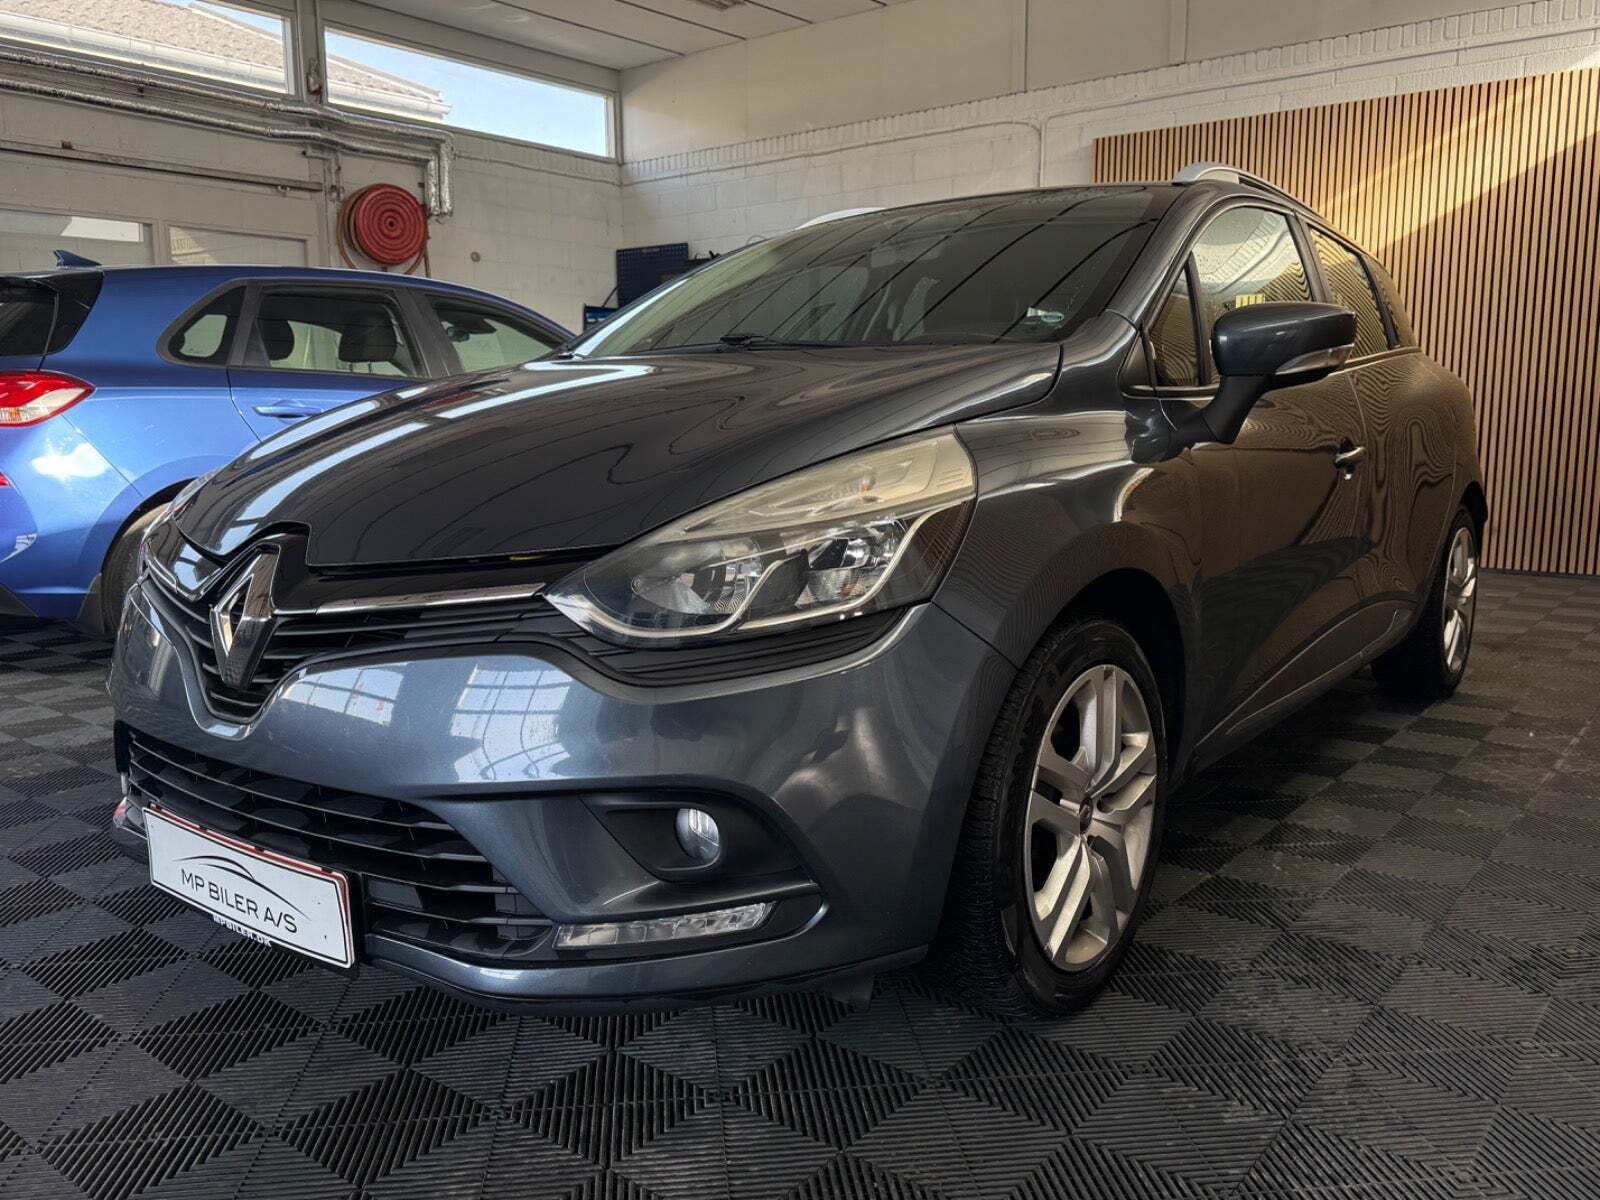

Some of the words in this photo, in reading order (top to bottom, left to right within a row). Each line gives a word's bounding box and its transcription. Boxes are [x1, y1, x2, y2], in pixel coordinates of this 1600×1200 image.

[181, 868, 205, 892] MP
[208, 881, 260, 920] BILER
[264, 906, 298, 934] A/S
